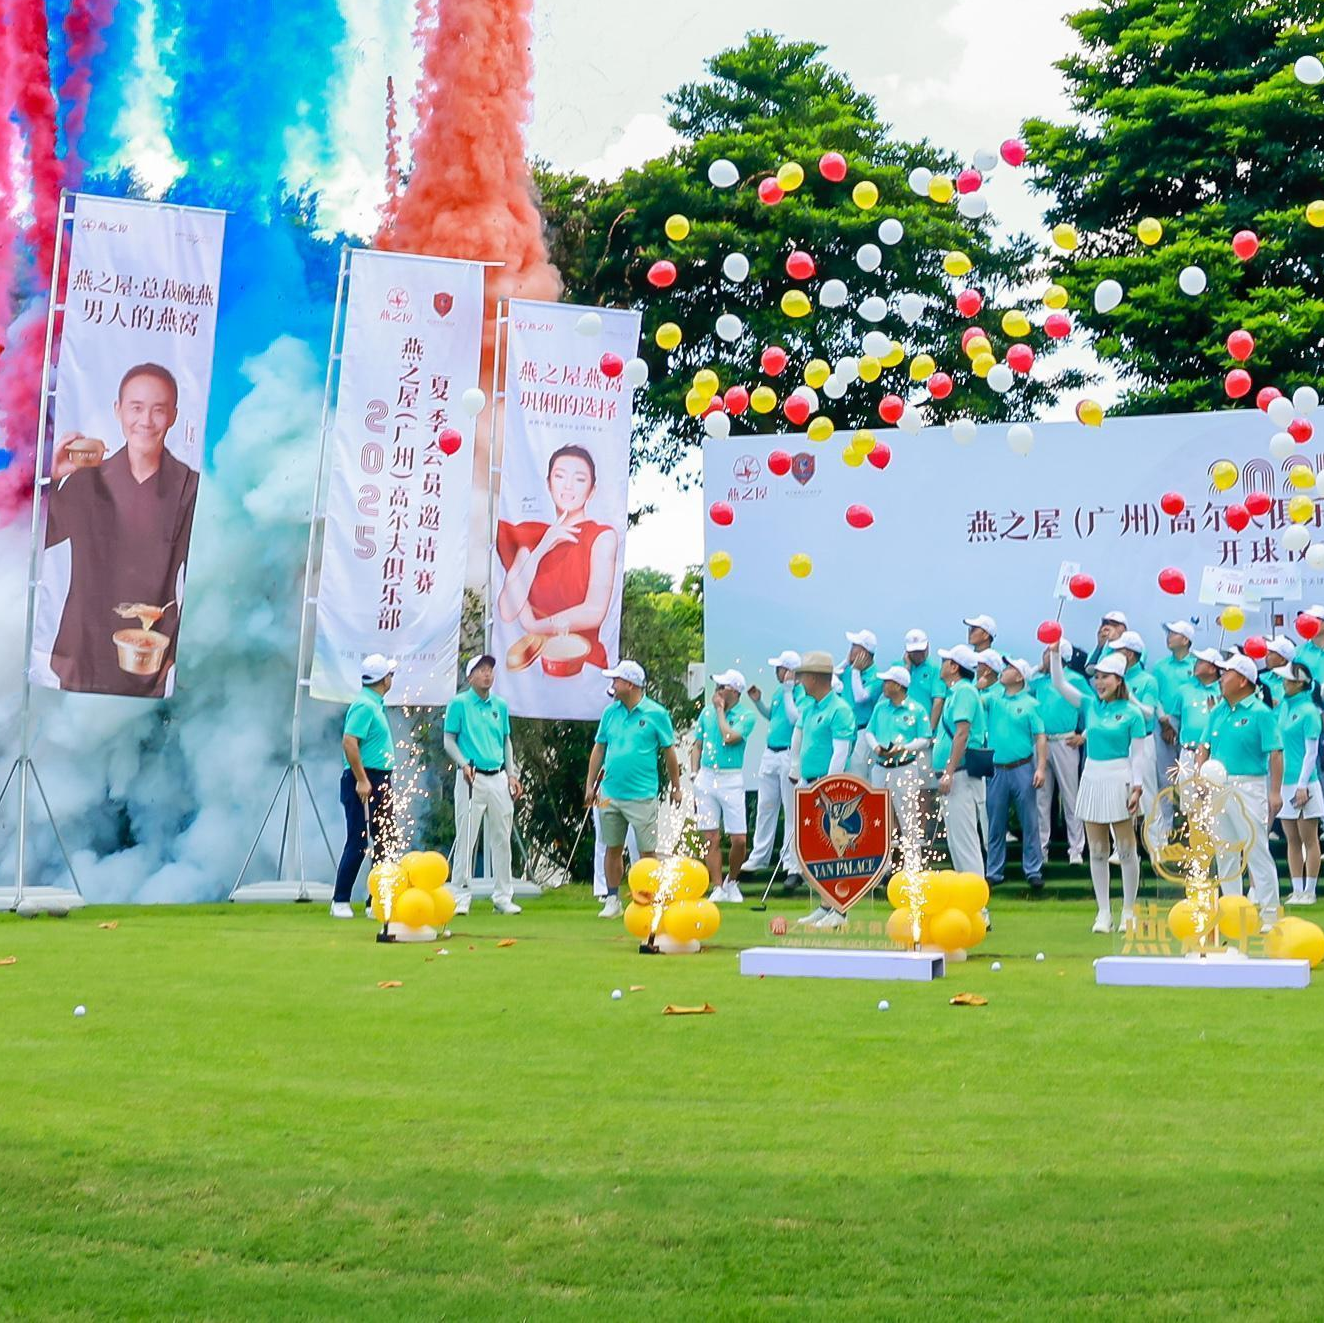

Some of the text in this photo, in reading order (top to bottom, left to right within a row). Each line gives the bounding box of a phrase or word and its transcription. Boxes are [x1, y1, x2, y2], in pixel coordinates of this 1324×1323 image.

[82, 299, 200, 337] 男人的燕窝
[354, 398, 389, 560] 2025
[414, 374, 452, 596] 夏季会员邀请赛
[813, 859, 875, 878] YAN PALACE
